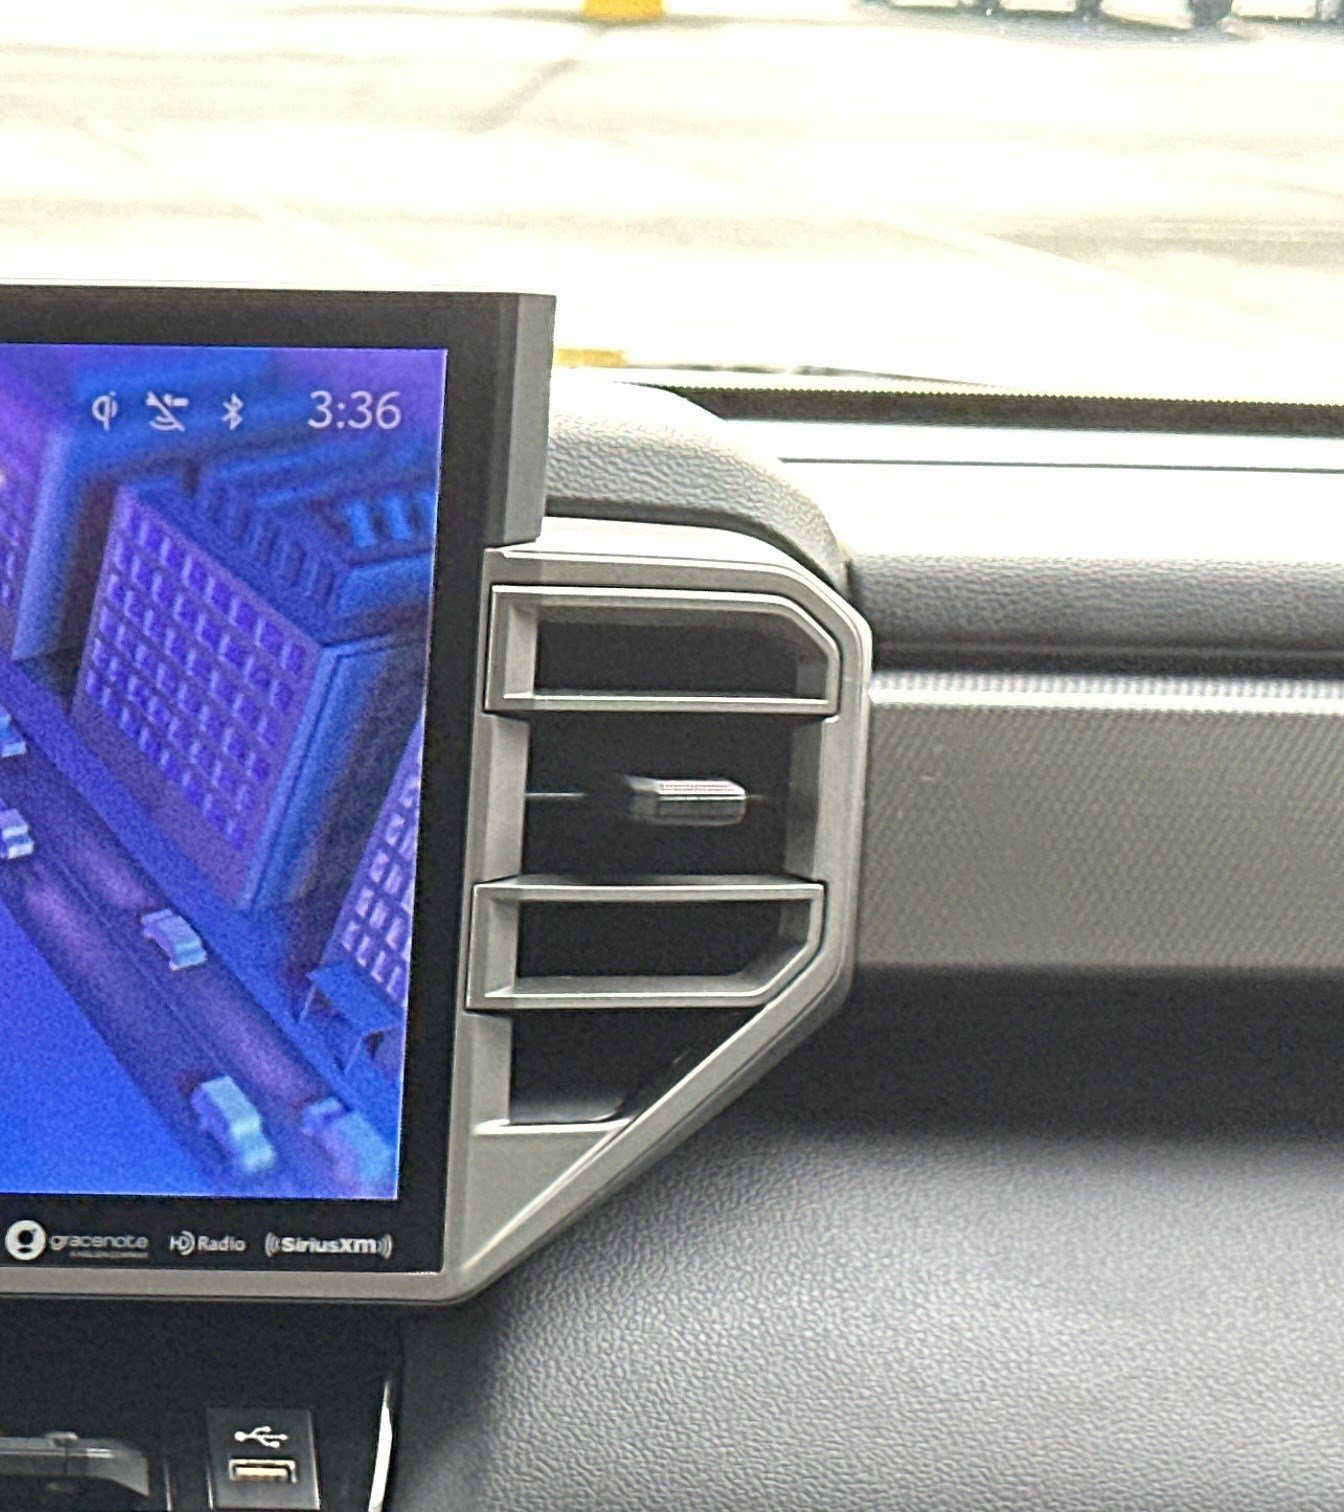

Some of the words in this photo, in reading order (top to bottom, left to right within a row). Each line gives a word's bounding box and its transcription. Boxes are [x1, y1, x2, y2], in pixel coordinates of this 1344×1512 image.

[307, 390, 402, 430] 3:36
[50, 1235, 150, 1251] gracenote
[197, 1234, 246, 1252] Radio
